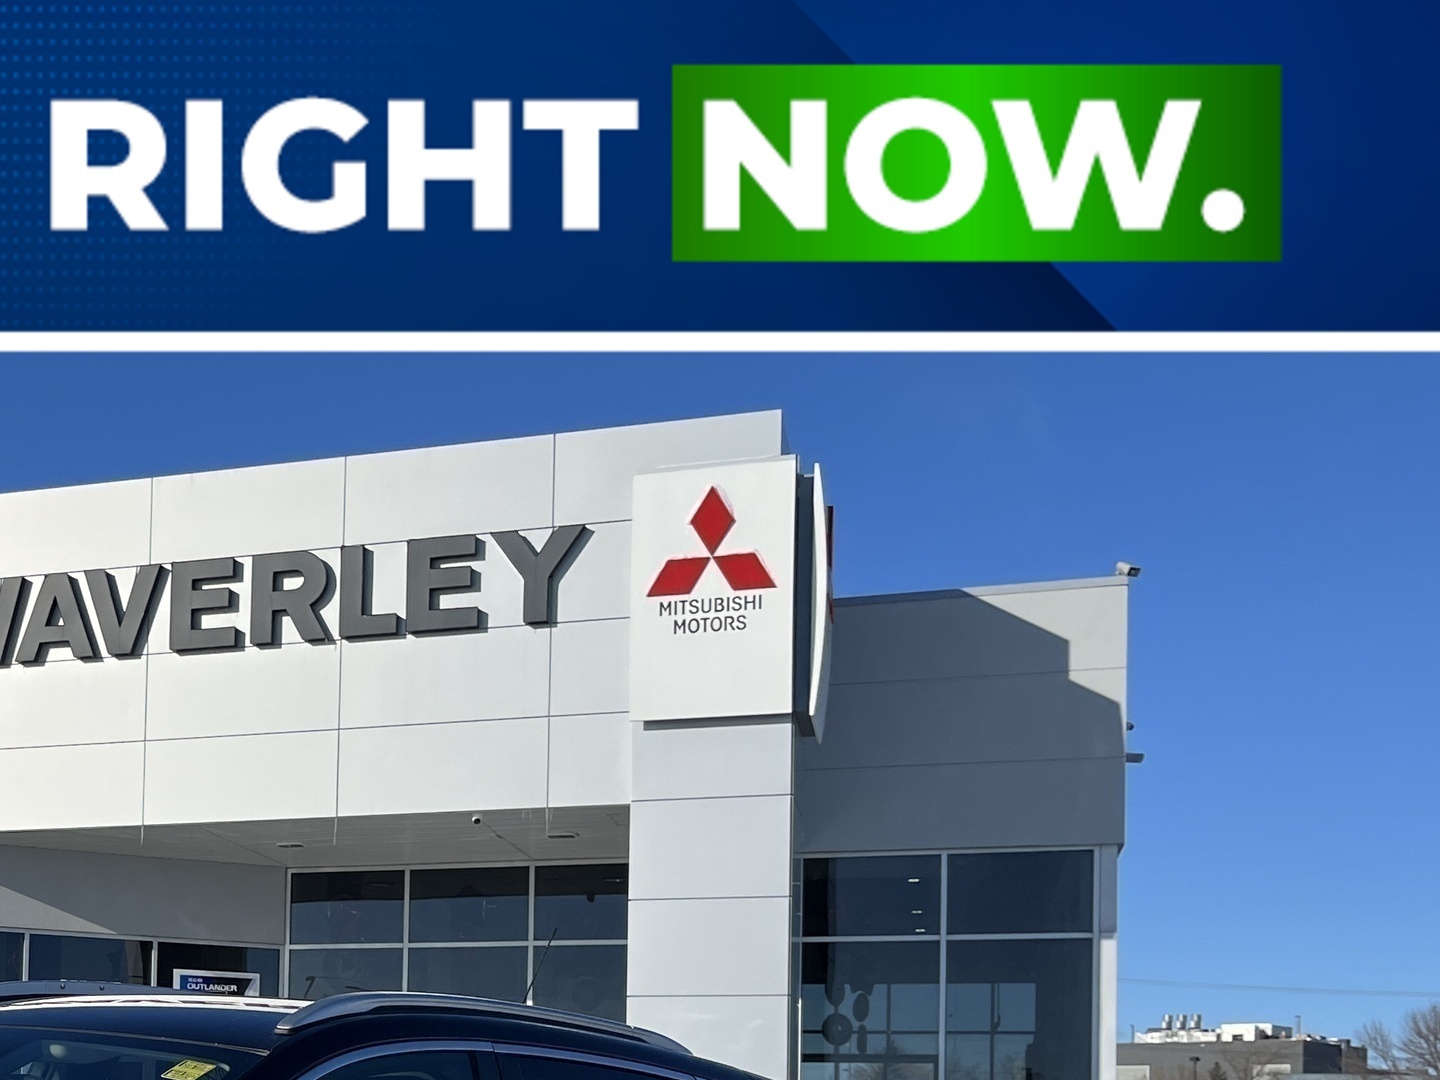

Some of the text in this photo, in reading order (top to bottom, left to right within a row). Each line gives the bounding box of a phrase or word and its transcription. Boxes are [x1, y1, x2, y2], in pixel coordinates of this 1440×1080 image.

[659, 594, 763, 616] MITSUBISHI
[673, 615, 747, 634] MOTORS
[186, 983, 238, 992] OUTLANDER
